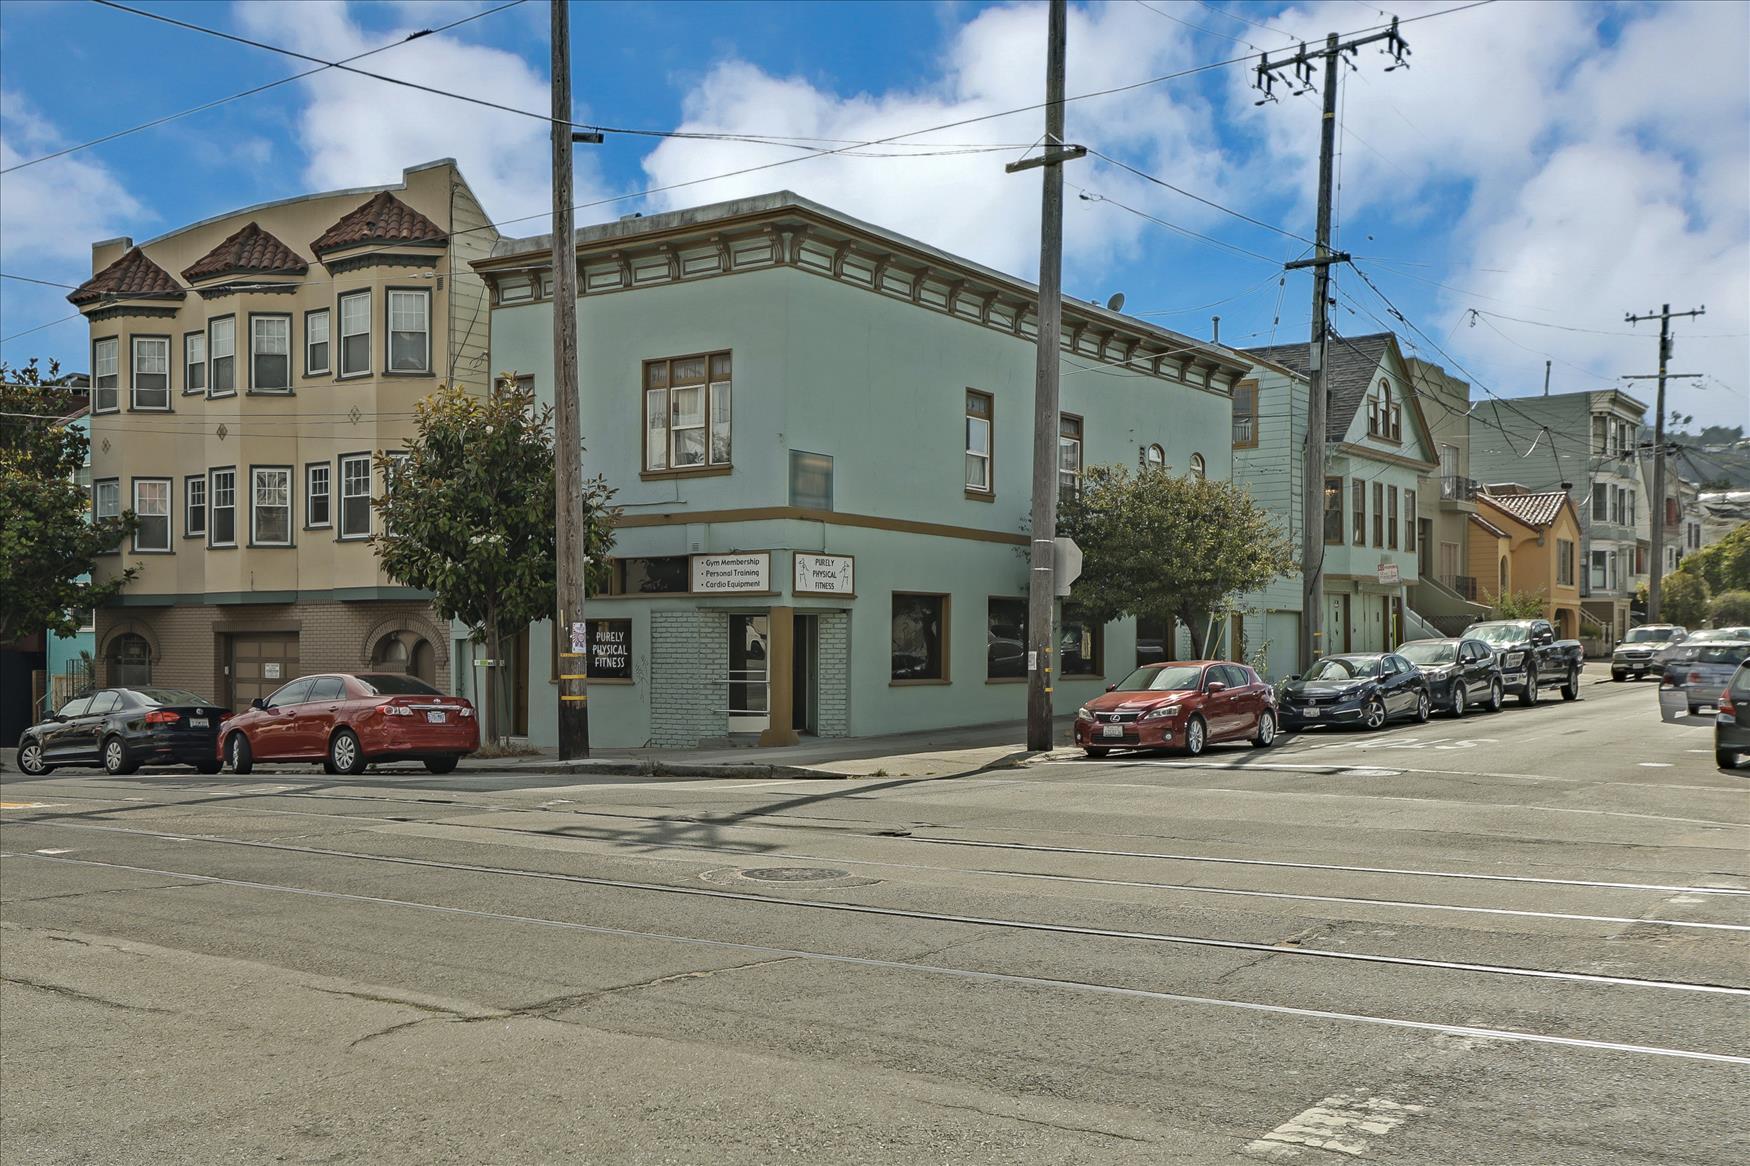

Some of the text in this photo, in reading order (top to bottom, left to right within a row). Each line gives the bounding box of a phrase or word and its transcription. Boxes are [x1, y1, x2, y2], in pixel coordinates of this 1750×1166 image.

[705, 558, 760, 567] Gym Membership
[815, 558, 835, 567] PURELY
[734, 569, 760, 577] Training
[812, 570, 837, 579] PHYSICAL
[727, 580, 760, 588] Equipment
[814, 581, 835, 590] FITNESS
[596, 631, 625, 642] PURELY
[592, 644, 628, 655] PHYSICAL
[594, 657, 625, 668] FITNESS
